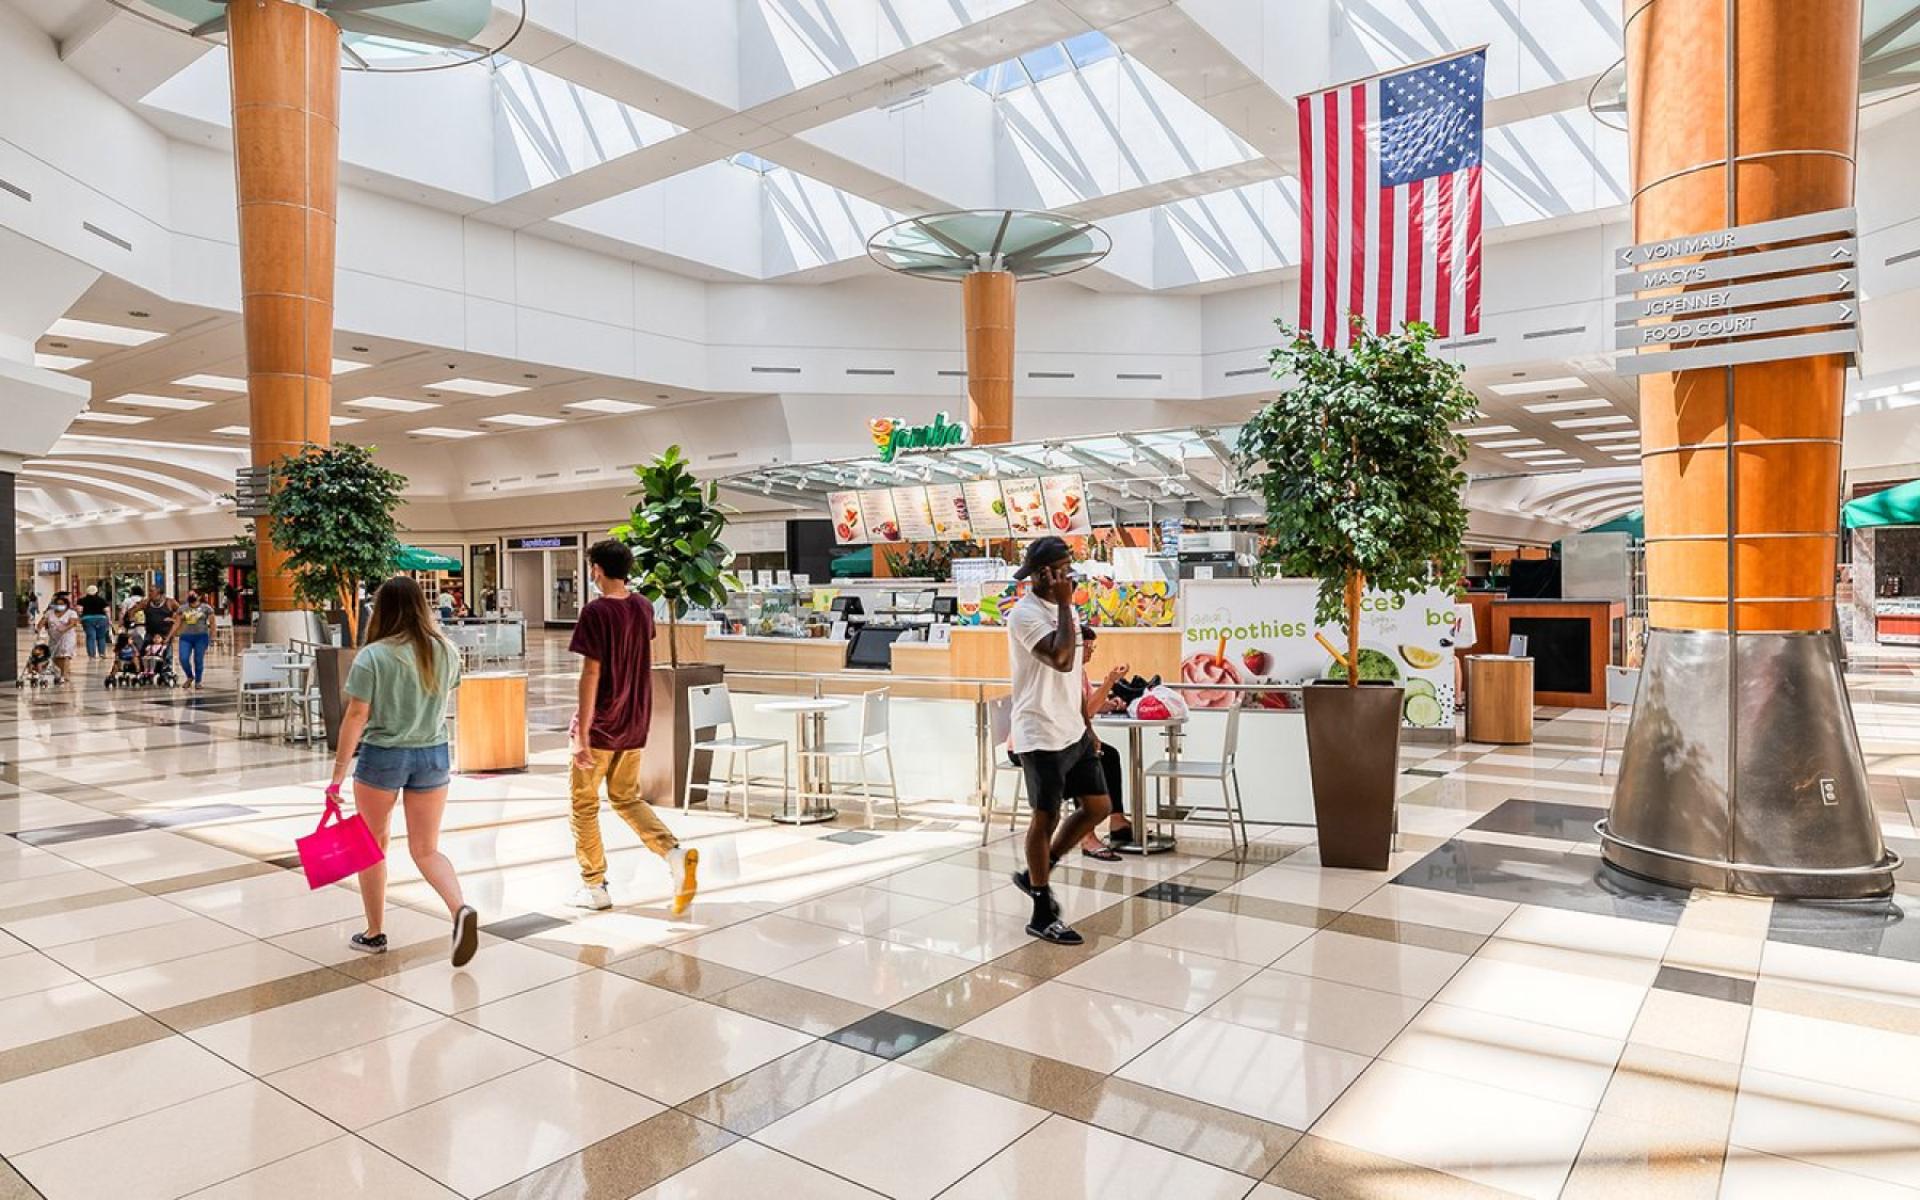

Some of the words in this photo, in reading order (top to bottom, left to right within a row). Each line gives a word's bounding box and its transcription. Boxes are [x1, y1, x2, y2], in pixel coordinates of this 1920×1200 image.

[1643, 241, 1681, 260] VON
[1685, 232, 1736, 254] MAUR
[1643, 265, 1706, 288] MACY'S
[1643, 292, 1731, 316] JCPENNEY
[1643, 324, 1694, 343] FOOD
[1697, 316, 1757, 337] COURT
[1186, 620, 1306, 642] smoothies
